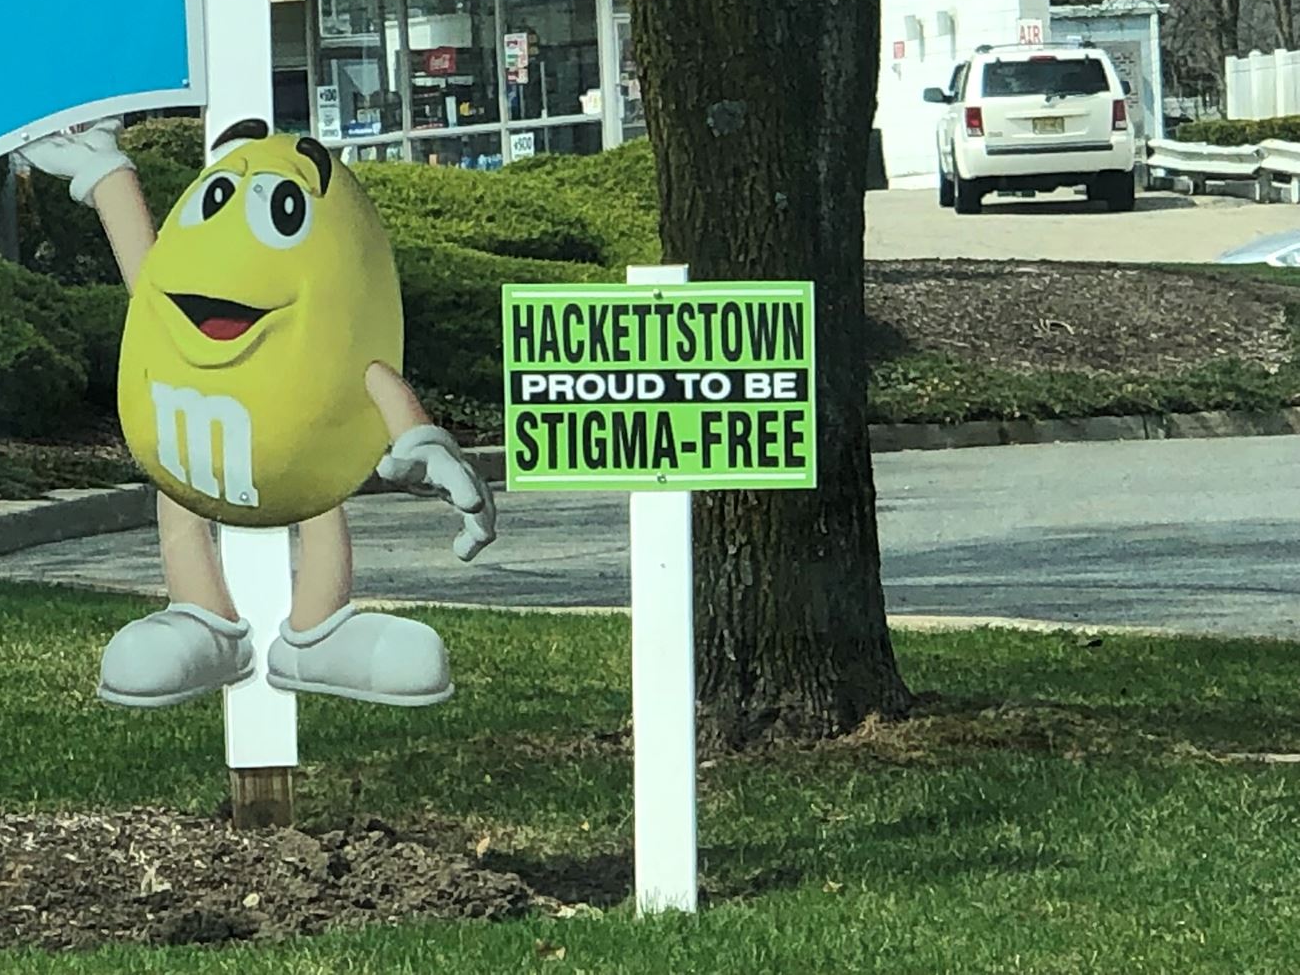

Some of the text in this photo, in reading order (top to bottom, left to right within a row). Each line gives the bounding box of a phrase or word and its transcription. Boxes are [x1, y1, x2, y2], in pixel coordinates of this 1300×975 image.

[1019, 24, 1042, 45] AIR
[511, 301, 804, 363] HACKETTSTOWN
[521, 372, 798, 401] PROUD TO BE
[151, 381, 260, 507] m
[515, 410, 806, 471] STIGMA-FREE
